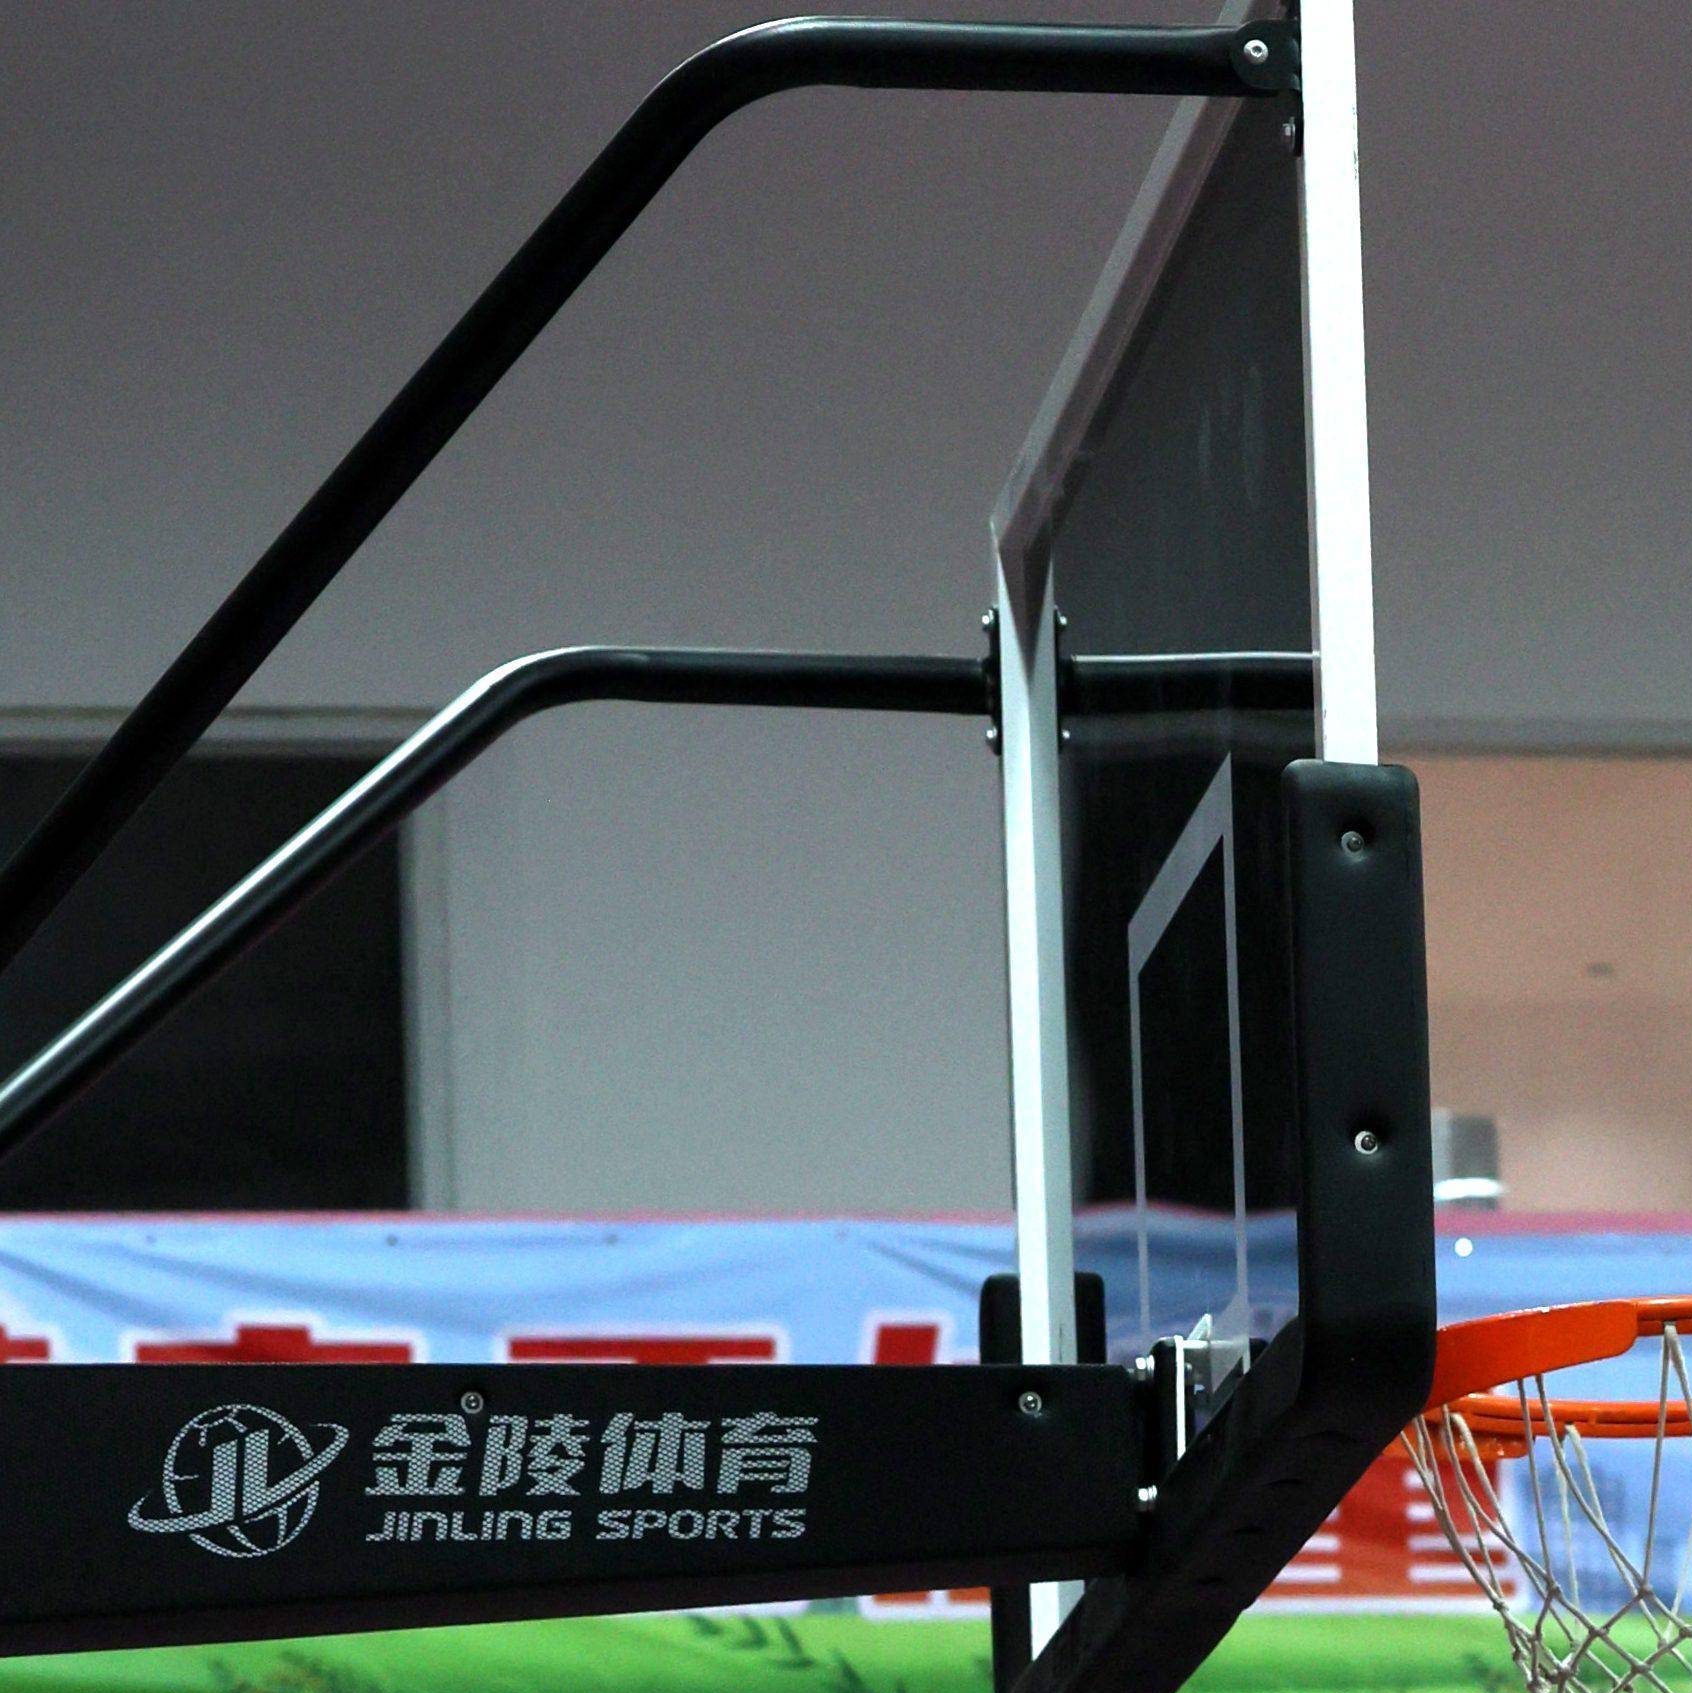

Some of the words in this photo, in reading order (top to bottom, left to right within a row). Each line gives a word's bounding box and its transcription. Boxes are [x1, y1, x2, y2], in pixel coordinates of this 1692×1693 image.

[364, 1411, 820, 1497] 金陵体育
[596, 1507, 807, 1541] SPORTS
